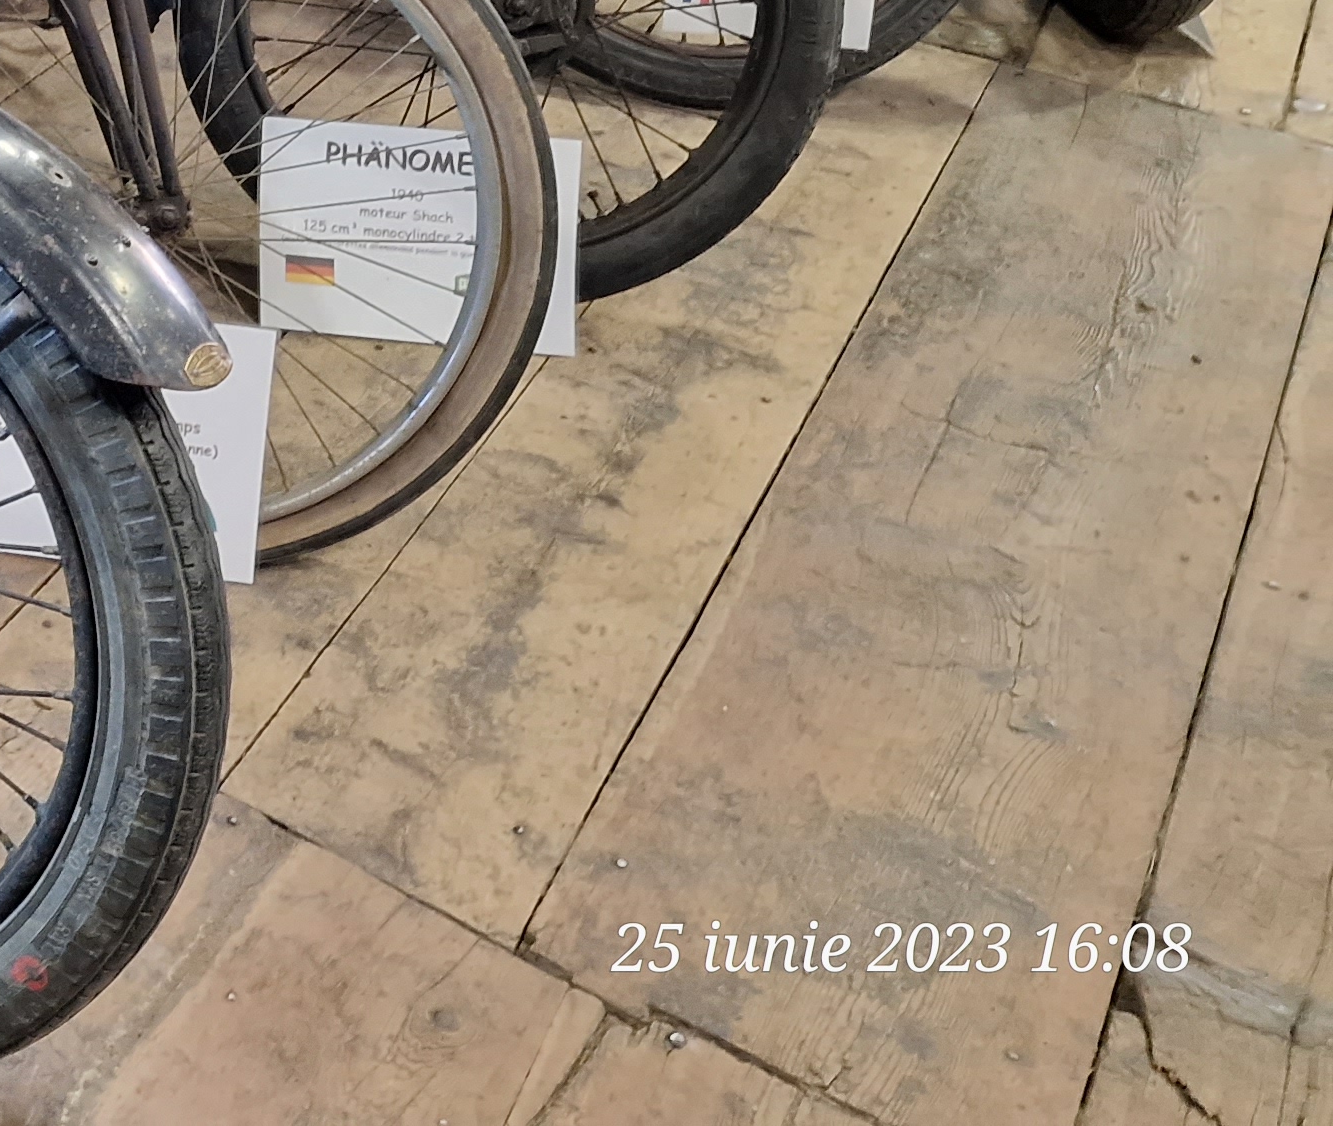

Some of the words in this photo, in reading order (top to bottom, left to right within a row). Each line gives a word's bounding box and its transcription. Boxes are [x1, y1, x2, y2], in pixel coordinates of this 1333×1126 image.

[359, 207, 408, 221] moteur
[412, 210, 454, 224] Shach
[303, 219, 327, 234] 125
[363, 227, 451, 243] monocylindre
